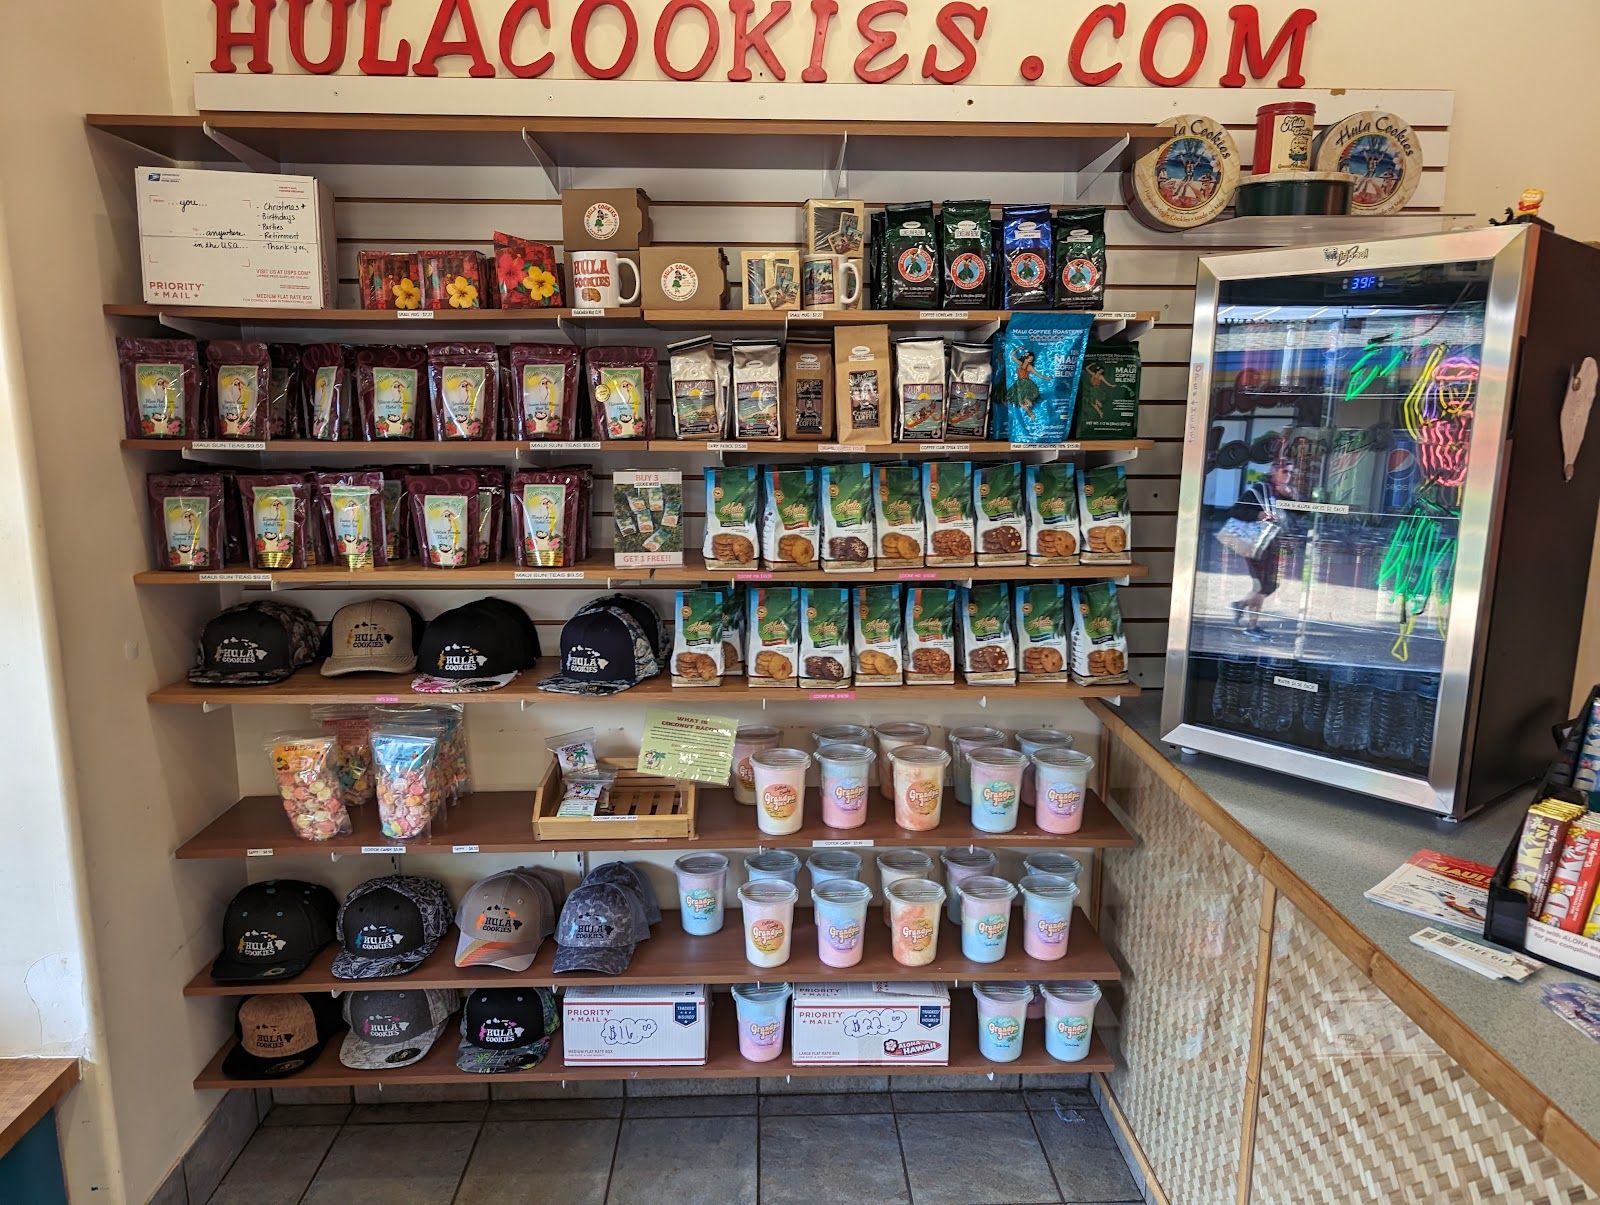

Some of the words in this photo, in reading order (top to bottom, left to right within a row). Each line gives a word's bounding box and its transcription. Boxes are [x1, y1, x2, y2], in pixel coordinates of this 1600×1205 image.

[1173, 124, 1186, 136] la
[1190, 120, 1231, 159] Cookies
[1335, 120, 1371, 146] Hula
[1375, 116, 1414, 157] Cookies
[263, 201, 299, 210] Christmas
[262, 213, 296, 223] Birthdays
[574, 259, 609, 275] HULA
[574, 277, 610, 288] COOKIES
[1352, 277, 1375, 289] 39F
[1054, 353, 1076, 364] MAU
[223, 649, 255, 658] HULA
[446, 656, 475, 664] HULA
[571, 657, 598, 666] HULA
[445, 663, 476, 671] COOKIES
[571, 665, 598, 673] COOKIES
[662, 721, 694, 729] COCONUT
[1426, 863, 1488, 881] MAUI
[485, 918, 511, 927] HULA
[363, 935, 393, 944] HULA
[1562, 935, 1589, 947] ALOHA
[245, 941, 274, 950] HULA
[1460, 943, 1486, 956] FREE
[486, 1028, 514, 1036] HULA
[256, 1033, 285, 1042] HULA
[485, 1035, 514, 1043] COOKIES
[898, 1041, 921, 1049] ALOHA
[903, 1042, 937, 1055] HAWAII
